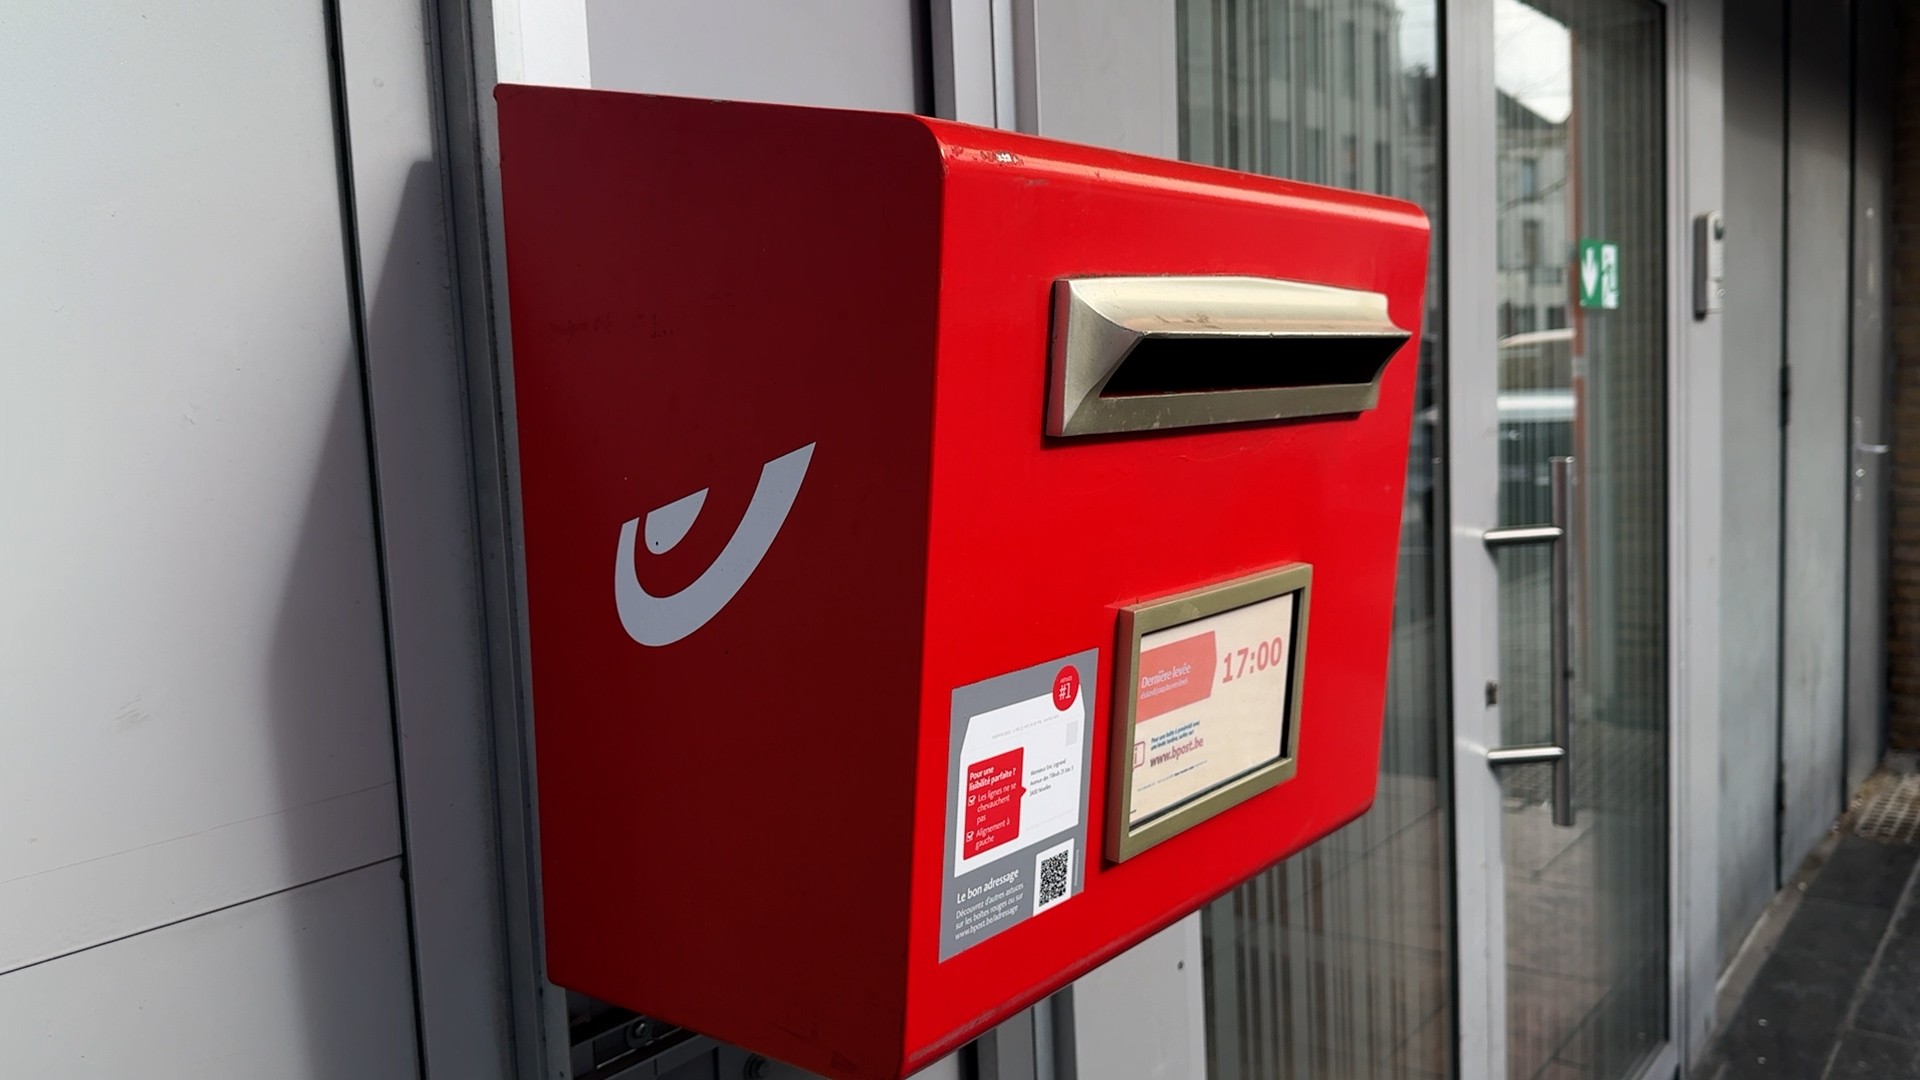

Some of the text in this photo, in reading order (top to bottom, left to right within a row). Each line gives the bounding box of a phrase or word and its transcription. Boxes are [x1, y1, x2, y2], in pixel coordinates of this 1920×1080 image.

[1222, 636, 1282, 684] 17:00
[1142, 662, 1191, 688] Dernière levée
[1058, 682, 1071, 700] #1
[1150, 736, 1204, 768] www.bpost.be
[969, 776, 991, 791] lisibilité
[991, 769, 1012, 785] parfaite
[970, 766, 994, 780] Pour une
[977, 794, 1010, 812] chevauchent
[978, 794, 987, 802] Les
[988, 787, 1002, 799] lignes
[976, 819, 1006, 838] Alignement
[1006, 817, 1011, 825] à
[977, 814, 986, 825] pas
[975, 834, 994, 850] gauche
[957, 869, 1019, 904] Le bon adressage
[956, 883, 1024, 919] Découvrez d'autres astuces
[955, 905, 1019, 940] www.bpost.be/adressage
[956, 920, 964, 930] sur
[990, 900, 1007, 912] rouges
